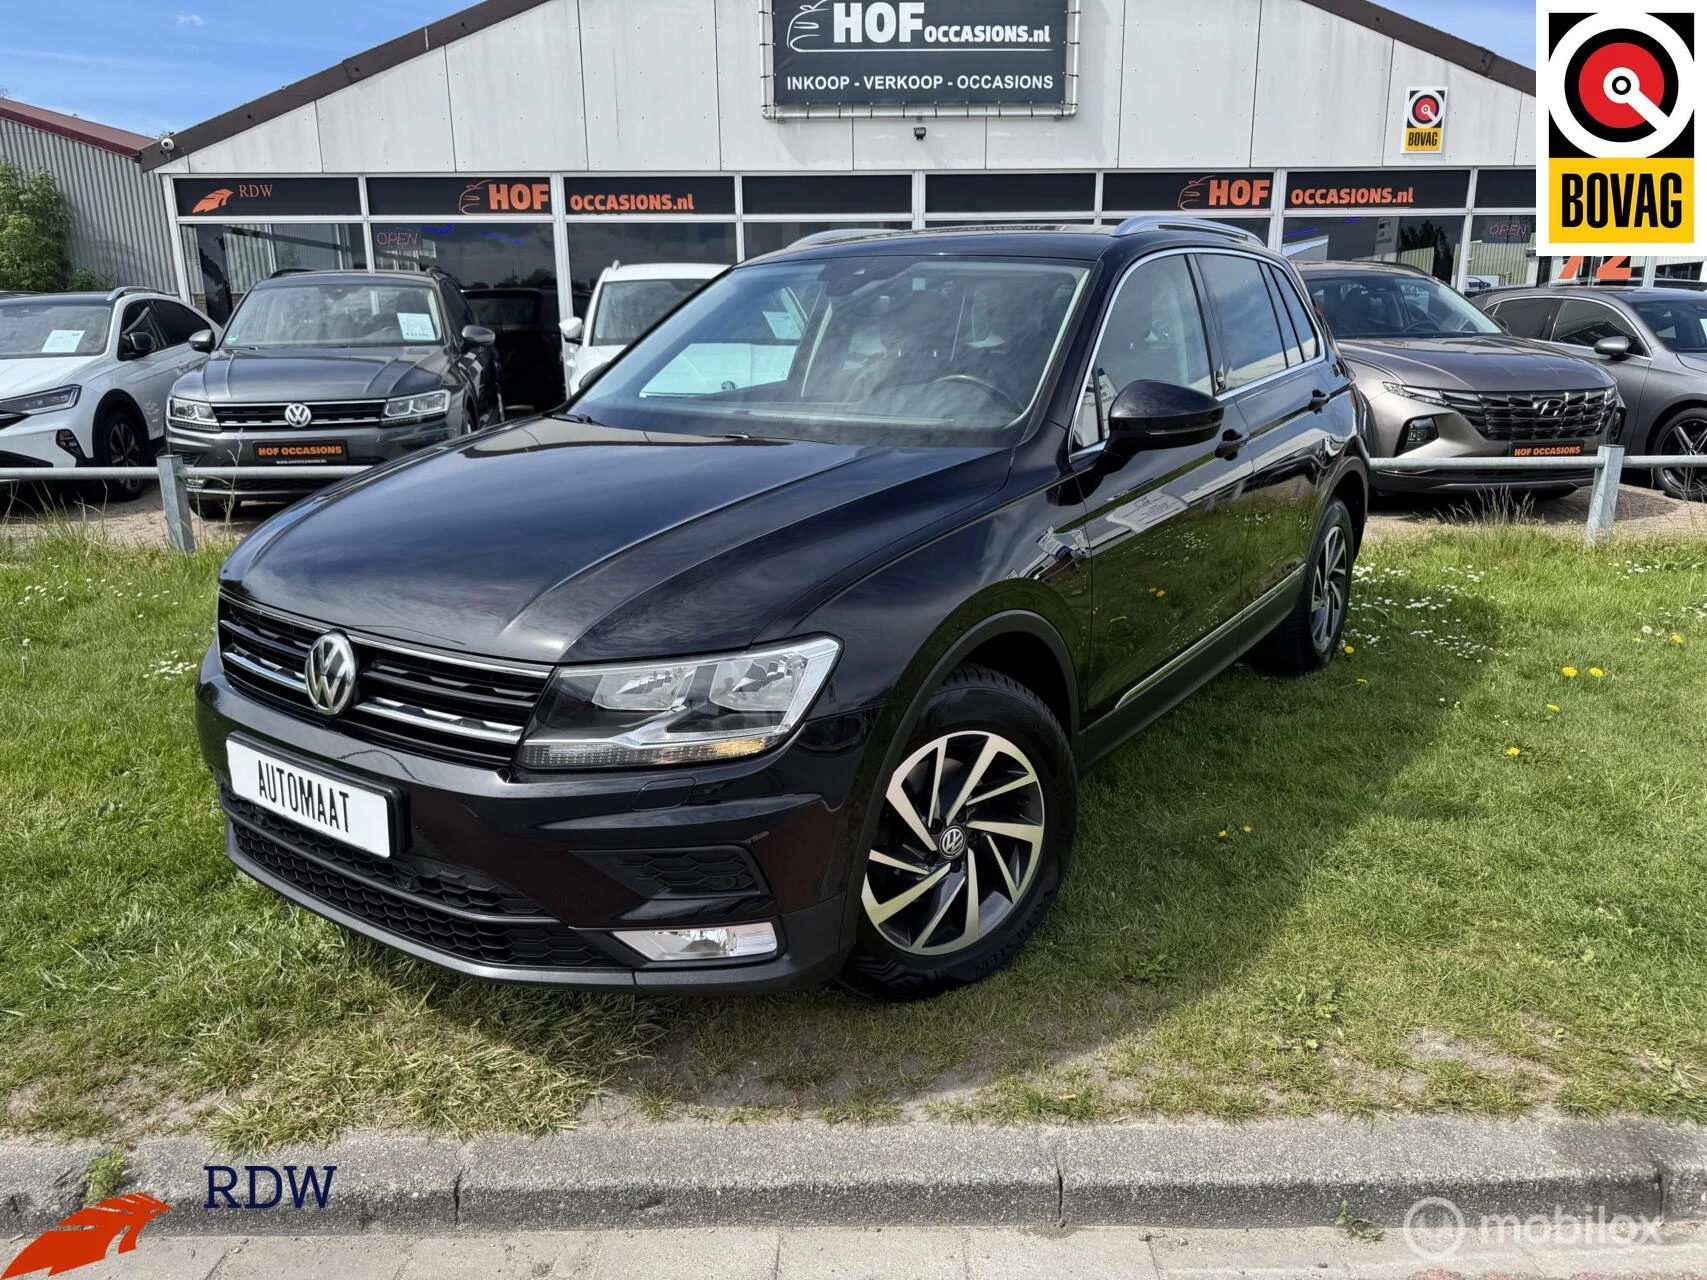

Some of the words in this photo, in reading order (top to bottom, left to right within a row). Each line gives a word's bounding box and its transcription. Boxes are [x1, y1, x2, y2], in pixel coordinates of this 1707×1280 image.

[787, 75, 850, 90] INKOOP
[863, 75, 944, 90] VERKOOP
[956, 74, 1054, 89] OCCASIONS
[1408, 131, 1438, 147] BOVAG
[239, 184, 273, 198] RDW
[488, 183, 550, 210] HOF
[570, 193, 694, 211] OCCASIONS.nl
[1208, 179, 1270, 206] HOF
[1291, 187, 1414, 205] OCCASIONS.nl
[1489, 223, 1527, 235] OPEN
[376, 232, 418, 246] OPEN
[258, 447, 280, 456] HOF
[281, 446, 343, 455] OCCASIONS
[1514, 448, 1532, 456] HOF
[1533, 446, 1581, 456] OCCASIONS
[257, 759, 351, 834] AUTOMAAT
